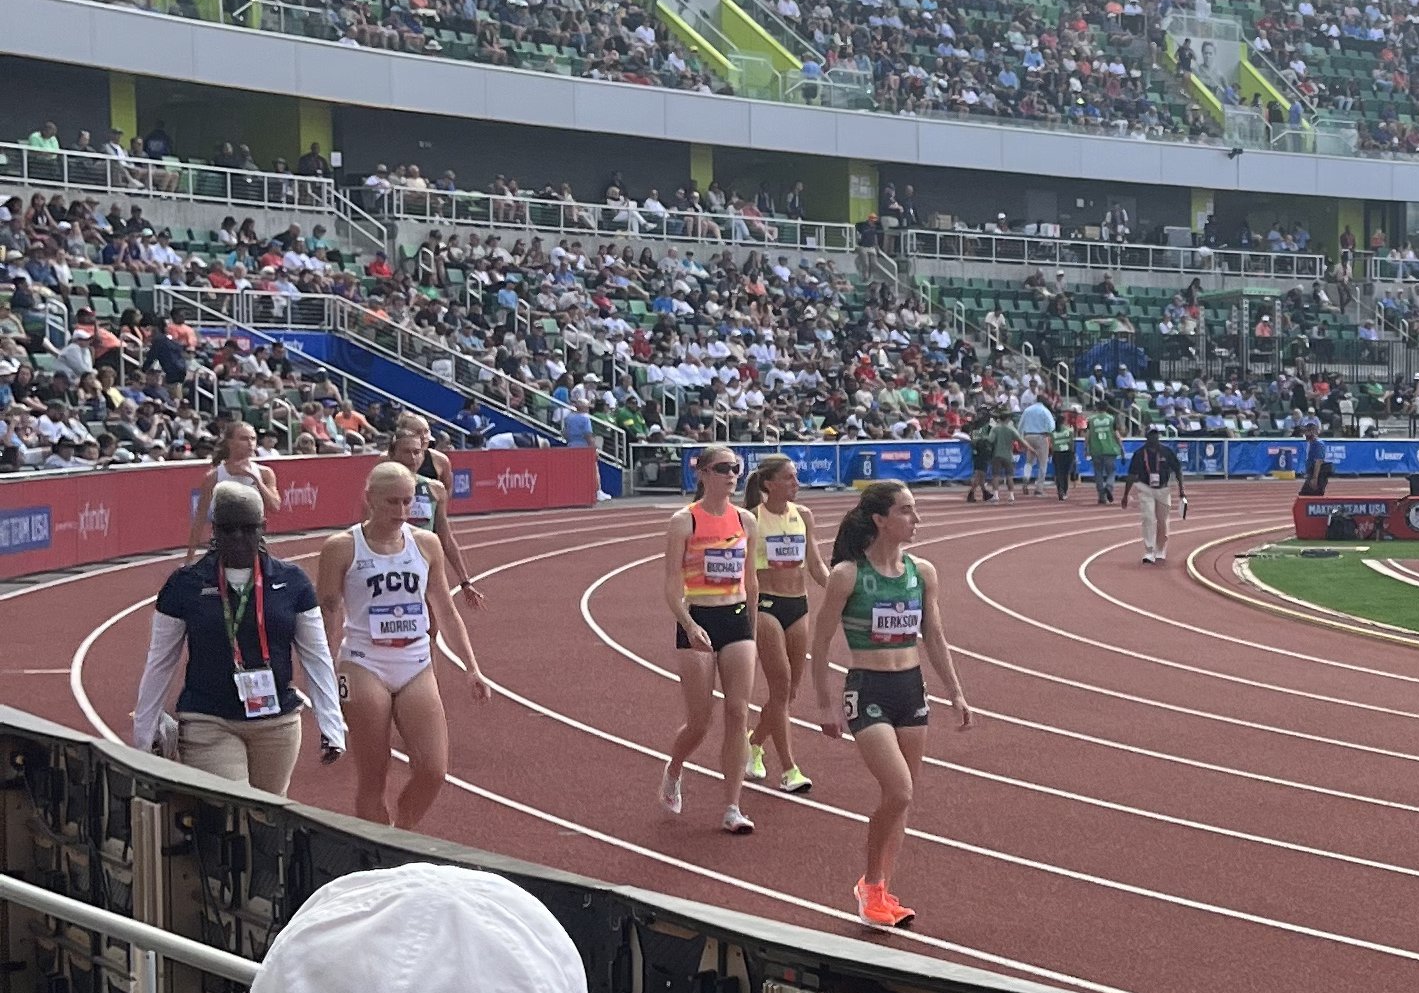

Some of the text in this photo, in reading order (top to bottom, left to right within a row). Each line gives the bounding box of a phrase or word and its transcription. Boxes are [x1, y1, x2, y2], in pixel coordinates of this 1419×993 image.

[497, 467, 537, 494] xfinity
[284, 482, 319, 514] xfinity
[1368, 504, 1386, 515] USA
[79, 502, 110, 539] xfinity
[366, 571, 420, 598] TCU
[380, 619, 418, 634] MORRIS
[877, 614, 919, 629] BERKSON
[339, 675, 348, 699] 6
[844, 693, 854, 717] 5
